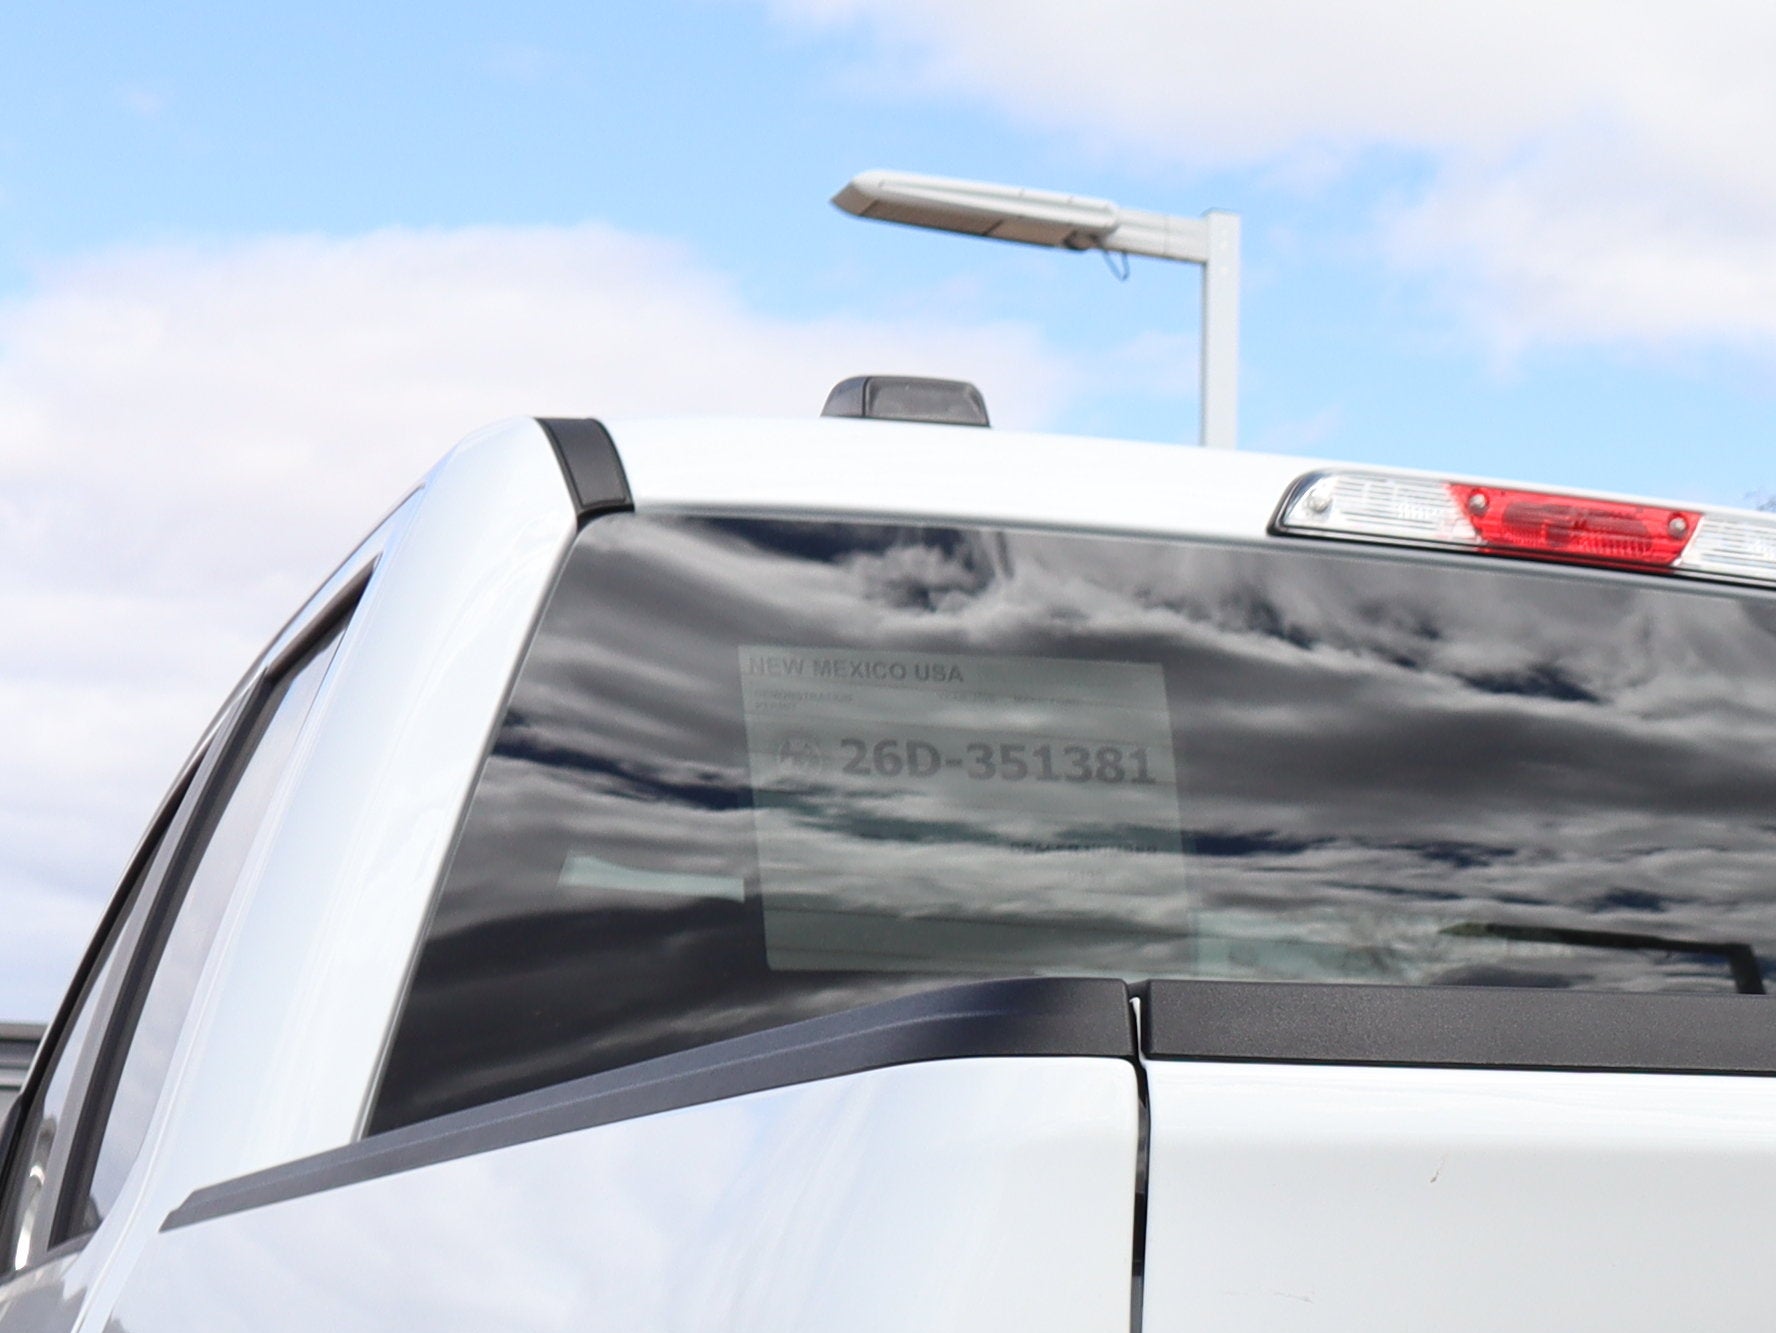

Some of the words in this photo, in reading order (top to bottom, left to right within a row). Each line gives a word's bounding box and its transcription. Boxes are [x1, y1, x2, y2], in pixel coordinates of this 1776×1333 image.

[748, 656, 804, 678] NEW
[812, 660, 908, 682] MEXICO
[914, 663, 964, 684] USA
[840, 737, 1157, 786] 26D-351381
